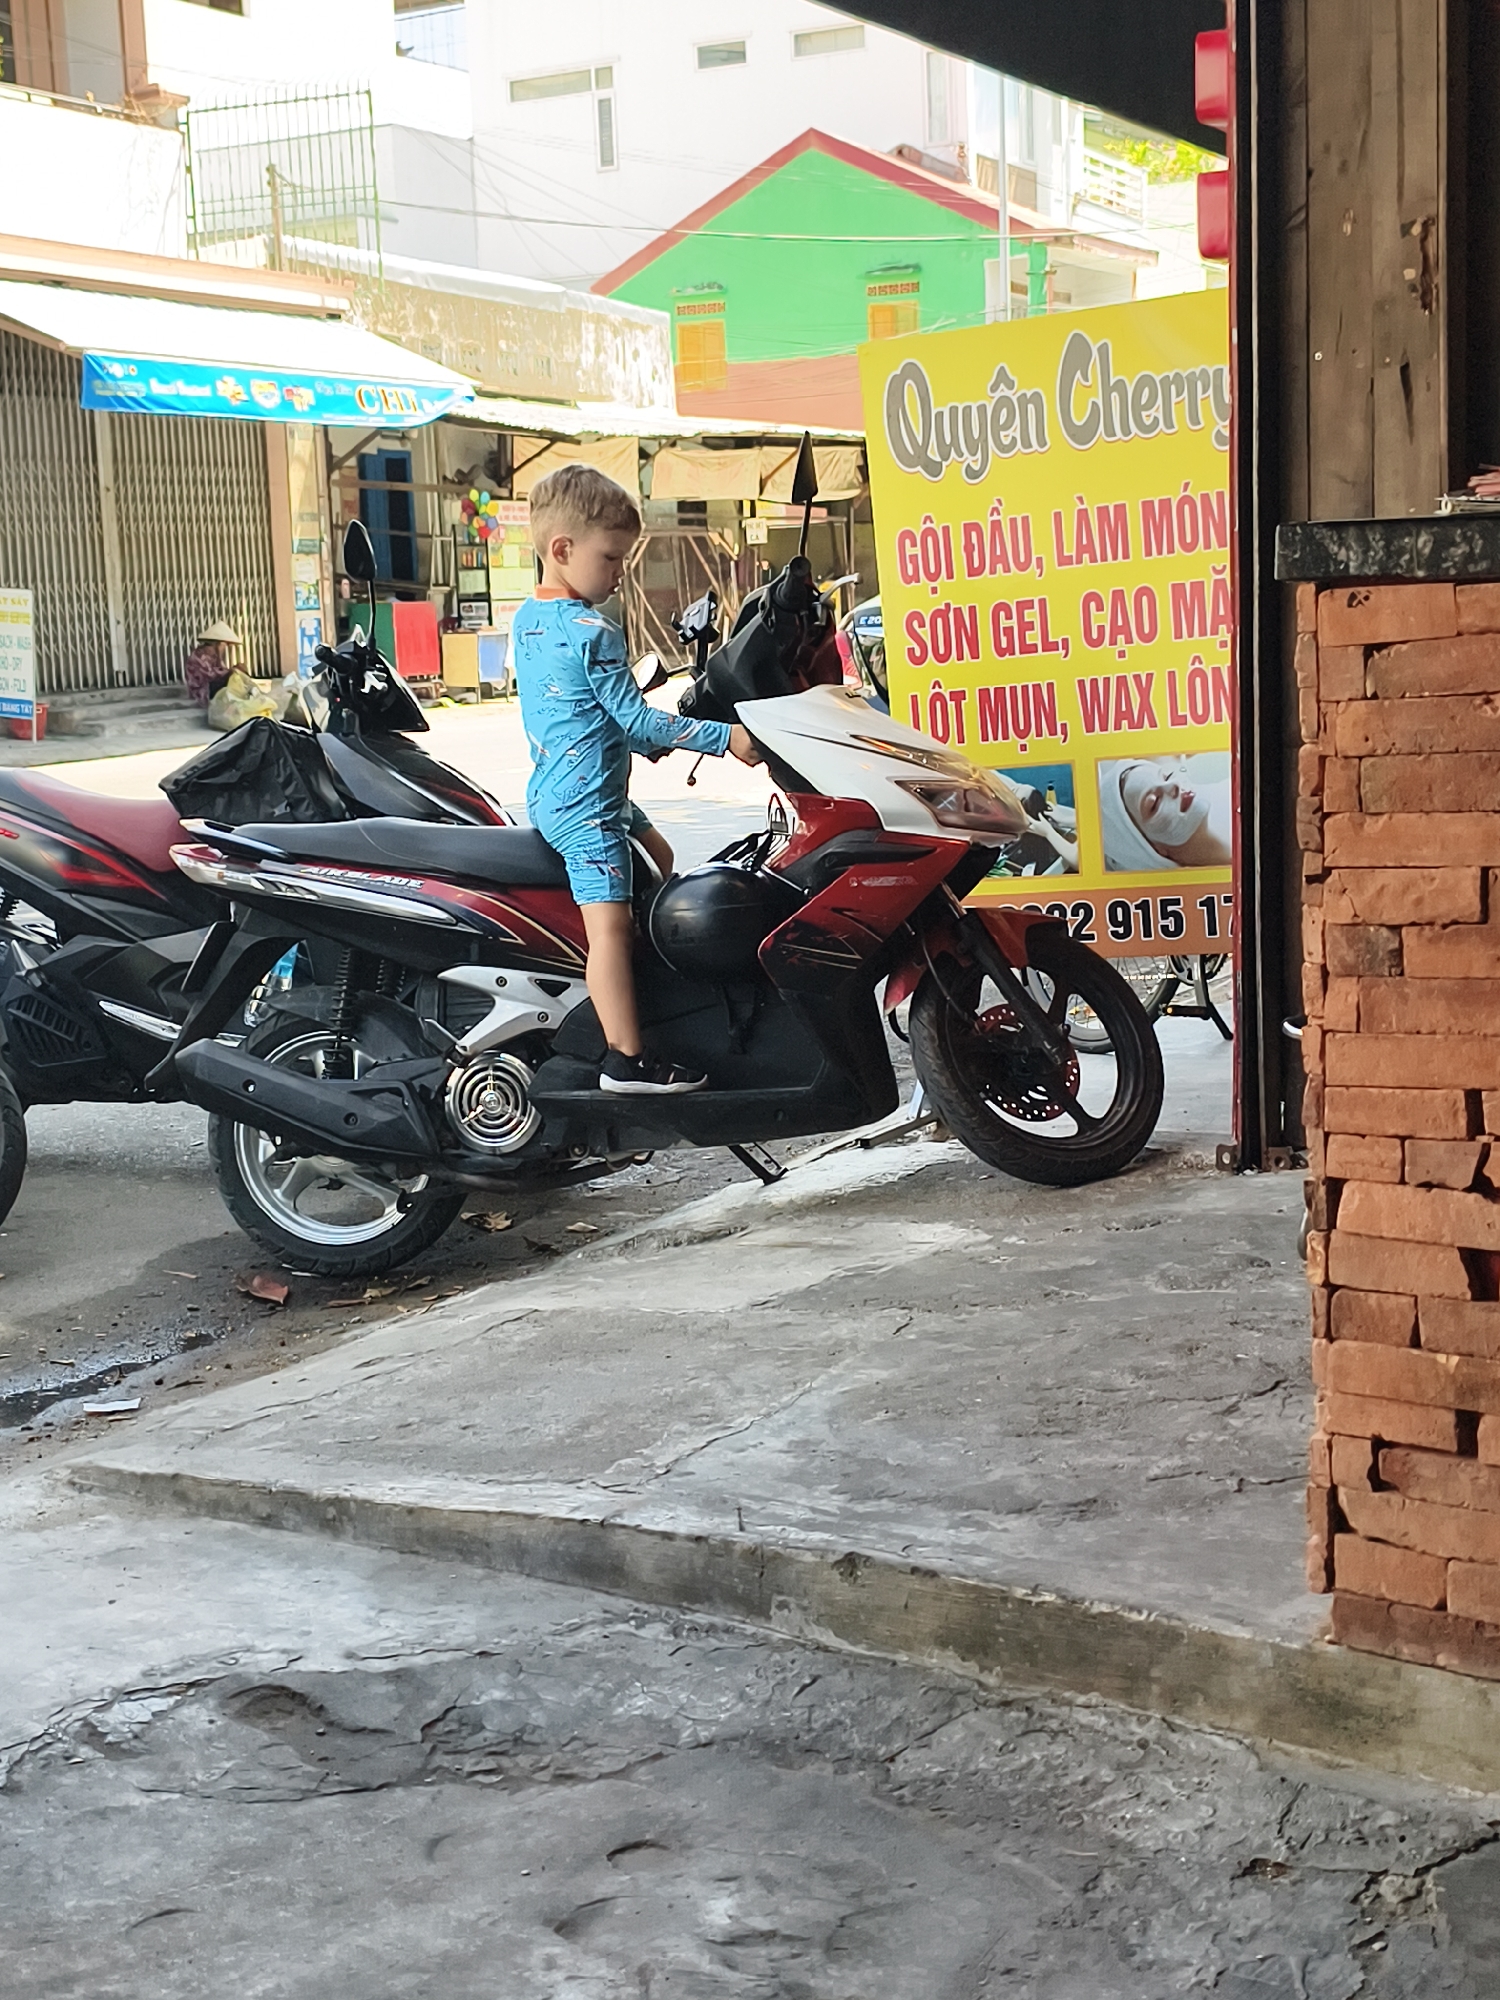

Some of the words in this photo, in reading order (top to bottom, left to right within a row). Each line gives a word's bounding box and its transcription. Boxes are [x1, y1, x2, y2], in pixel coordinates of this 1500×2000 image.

[885, 359, 1049, 483] Quyên
[1058, 330, 1231, 450] Cherry
[898, 515, 954, 595] GỘI
[962, 498, 1043, 577] ĐẦU,
[1053, 496, 1130, 567] LÀM
[905, 603, 980, 667] SƠN
[991, 597, 1069, 658] GEL,
[1081, 585, 1158, 659] CẠO
[978, 681, 1069, 752] MỤN,
[1077, 672, 1157, 734] WAX
[1107, 897, 1184, 941] 915
